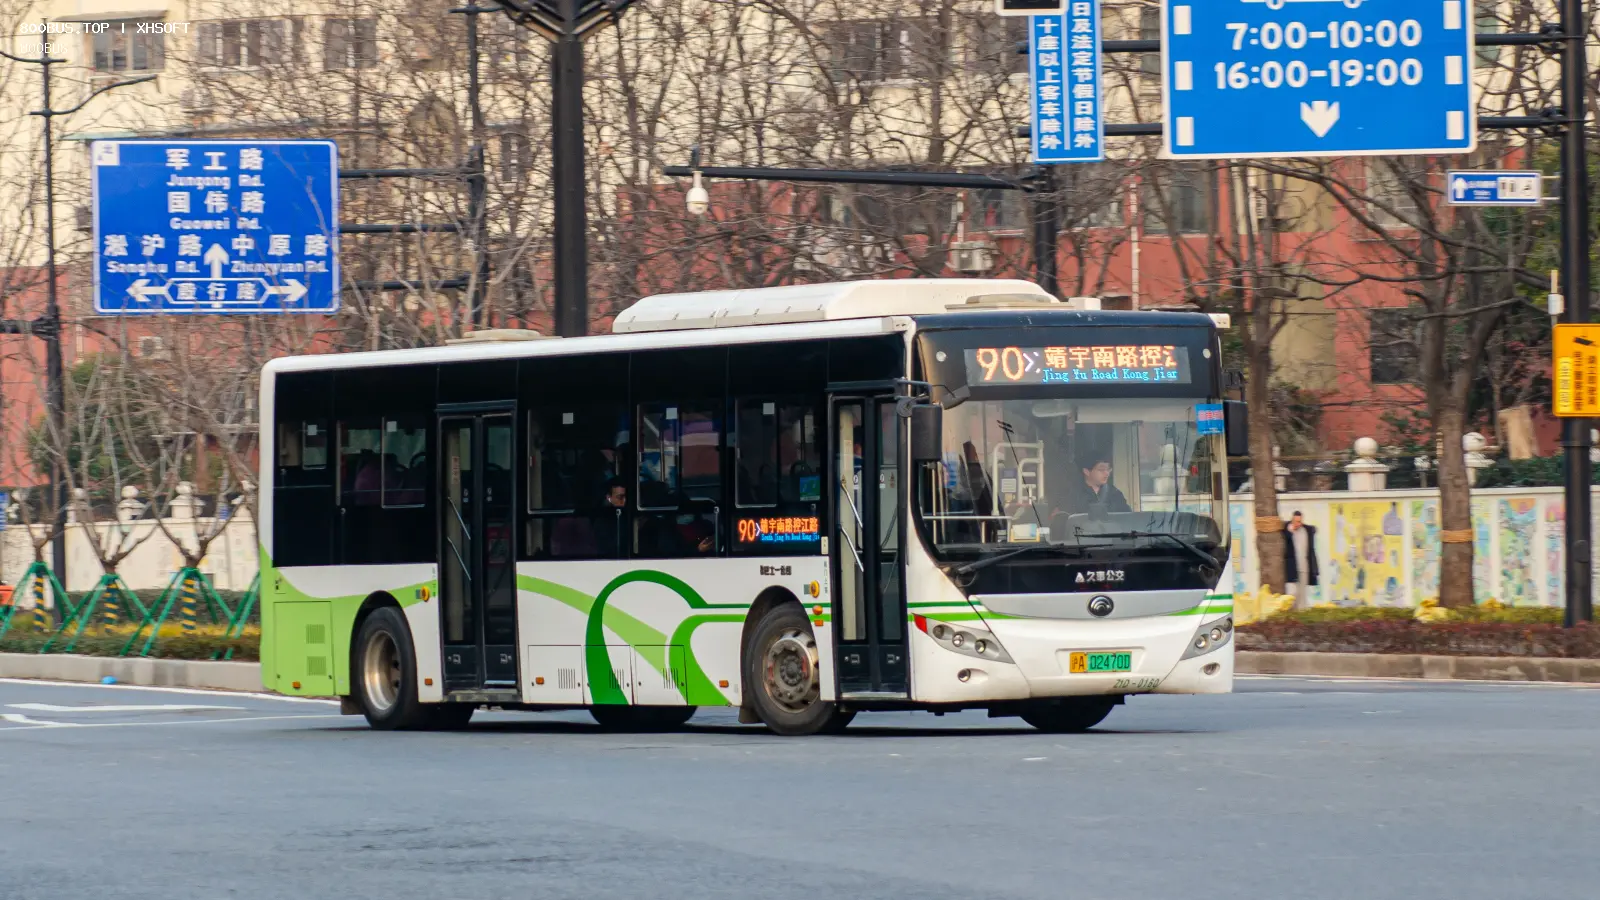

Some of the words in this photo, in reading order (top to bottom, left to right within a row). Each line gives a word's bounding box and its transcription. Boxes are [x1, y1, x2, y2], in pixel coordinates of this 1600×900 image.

[1226, 19, 1423, 50] 7:00-10:00
[1214, 58, 1424, 90] 16:00-19:00
[165, 148, 264, 170] 军工路
[166, 174, 231, 190] Jungong
[167, 190, 265, 213] 国伟路
[169, 217, 230, 229] Guowei
[231, 233, 329, 257] 中原路
[976, 346, 1024, 381] 90
[1043, 368, 1068, 382] Jing
[1072, 368, 1087, 380] Yu
[1091, 367, 1118, 380] Road
[1122, 367, 1149, 381] Kong
[738, 519, 756, 542] 90
[1086, 569, 1125, 583] 久事公交
